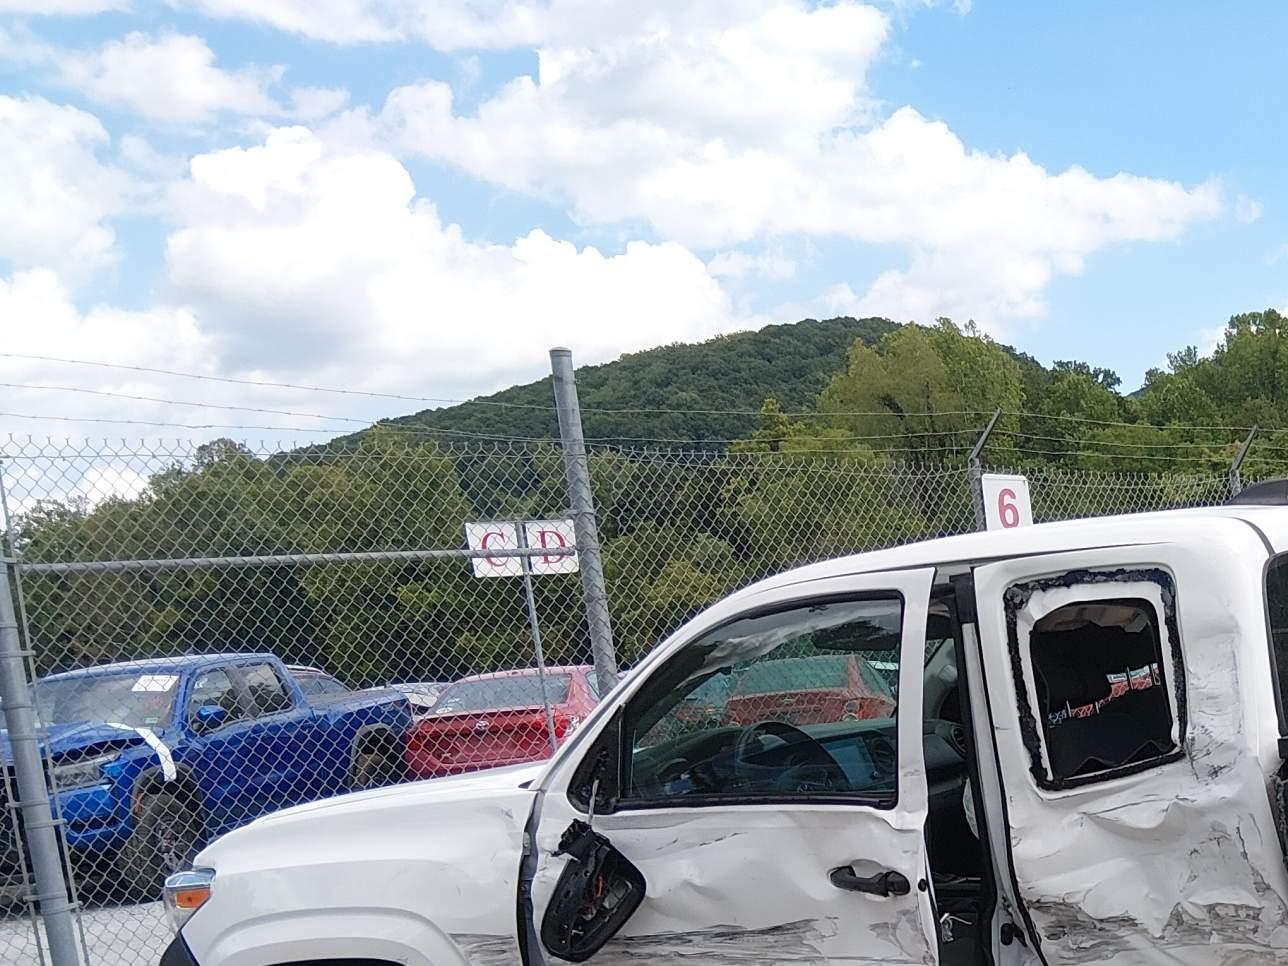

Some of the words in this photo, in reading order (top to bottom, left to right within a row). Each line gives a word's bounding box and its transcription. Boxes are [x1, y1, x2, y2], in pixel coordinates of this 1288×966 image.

[998, 488, 1020, 528] 6
[481, 531, 508, 567] C
[536, 529, 566, 564] D
